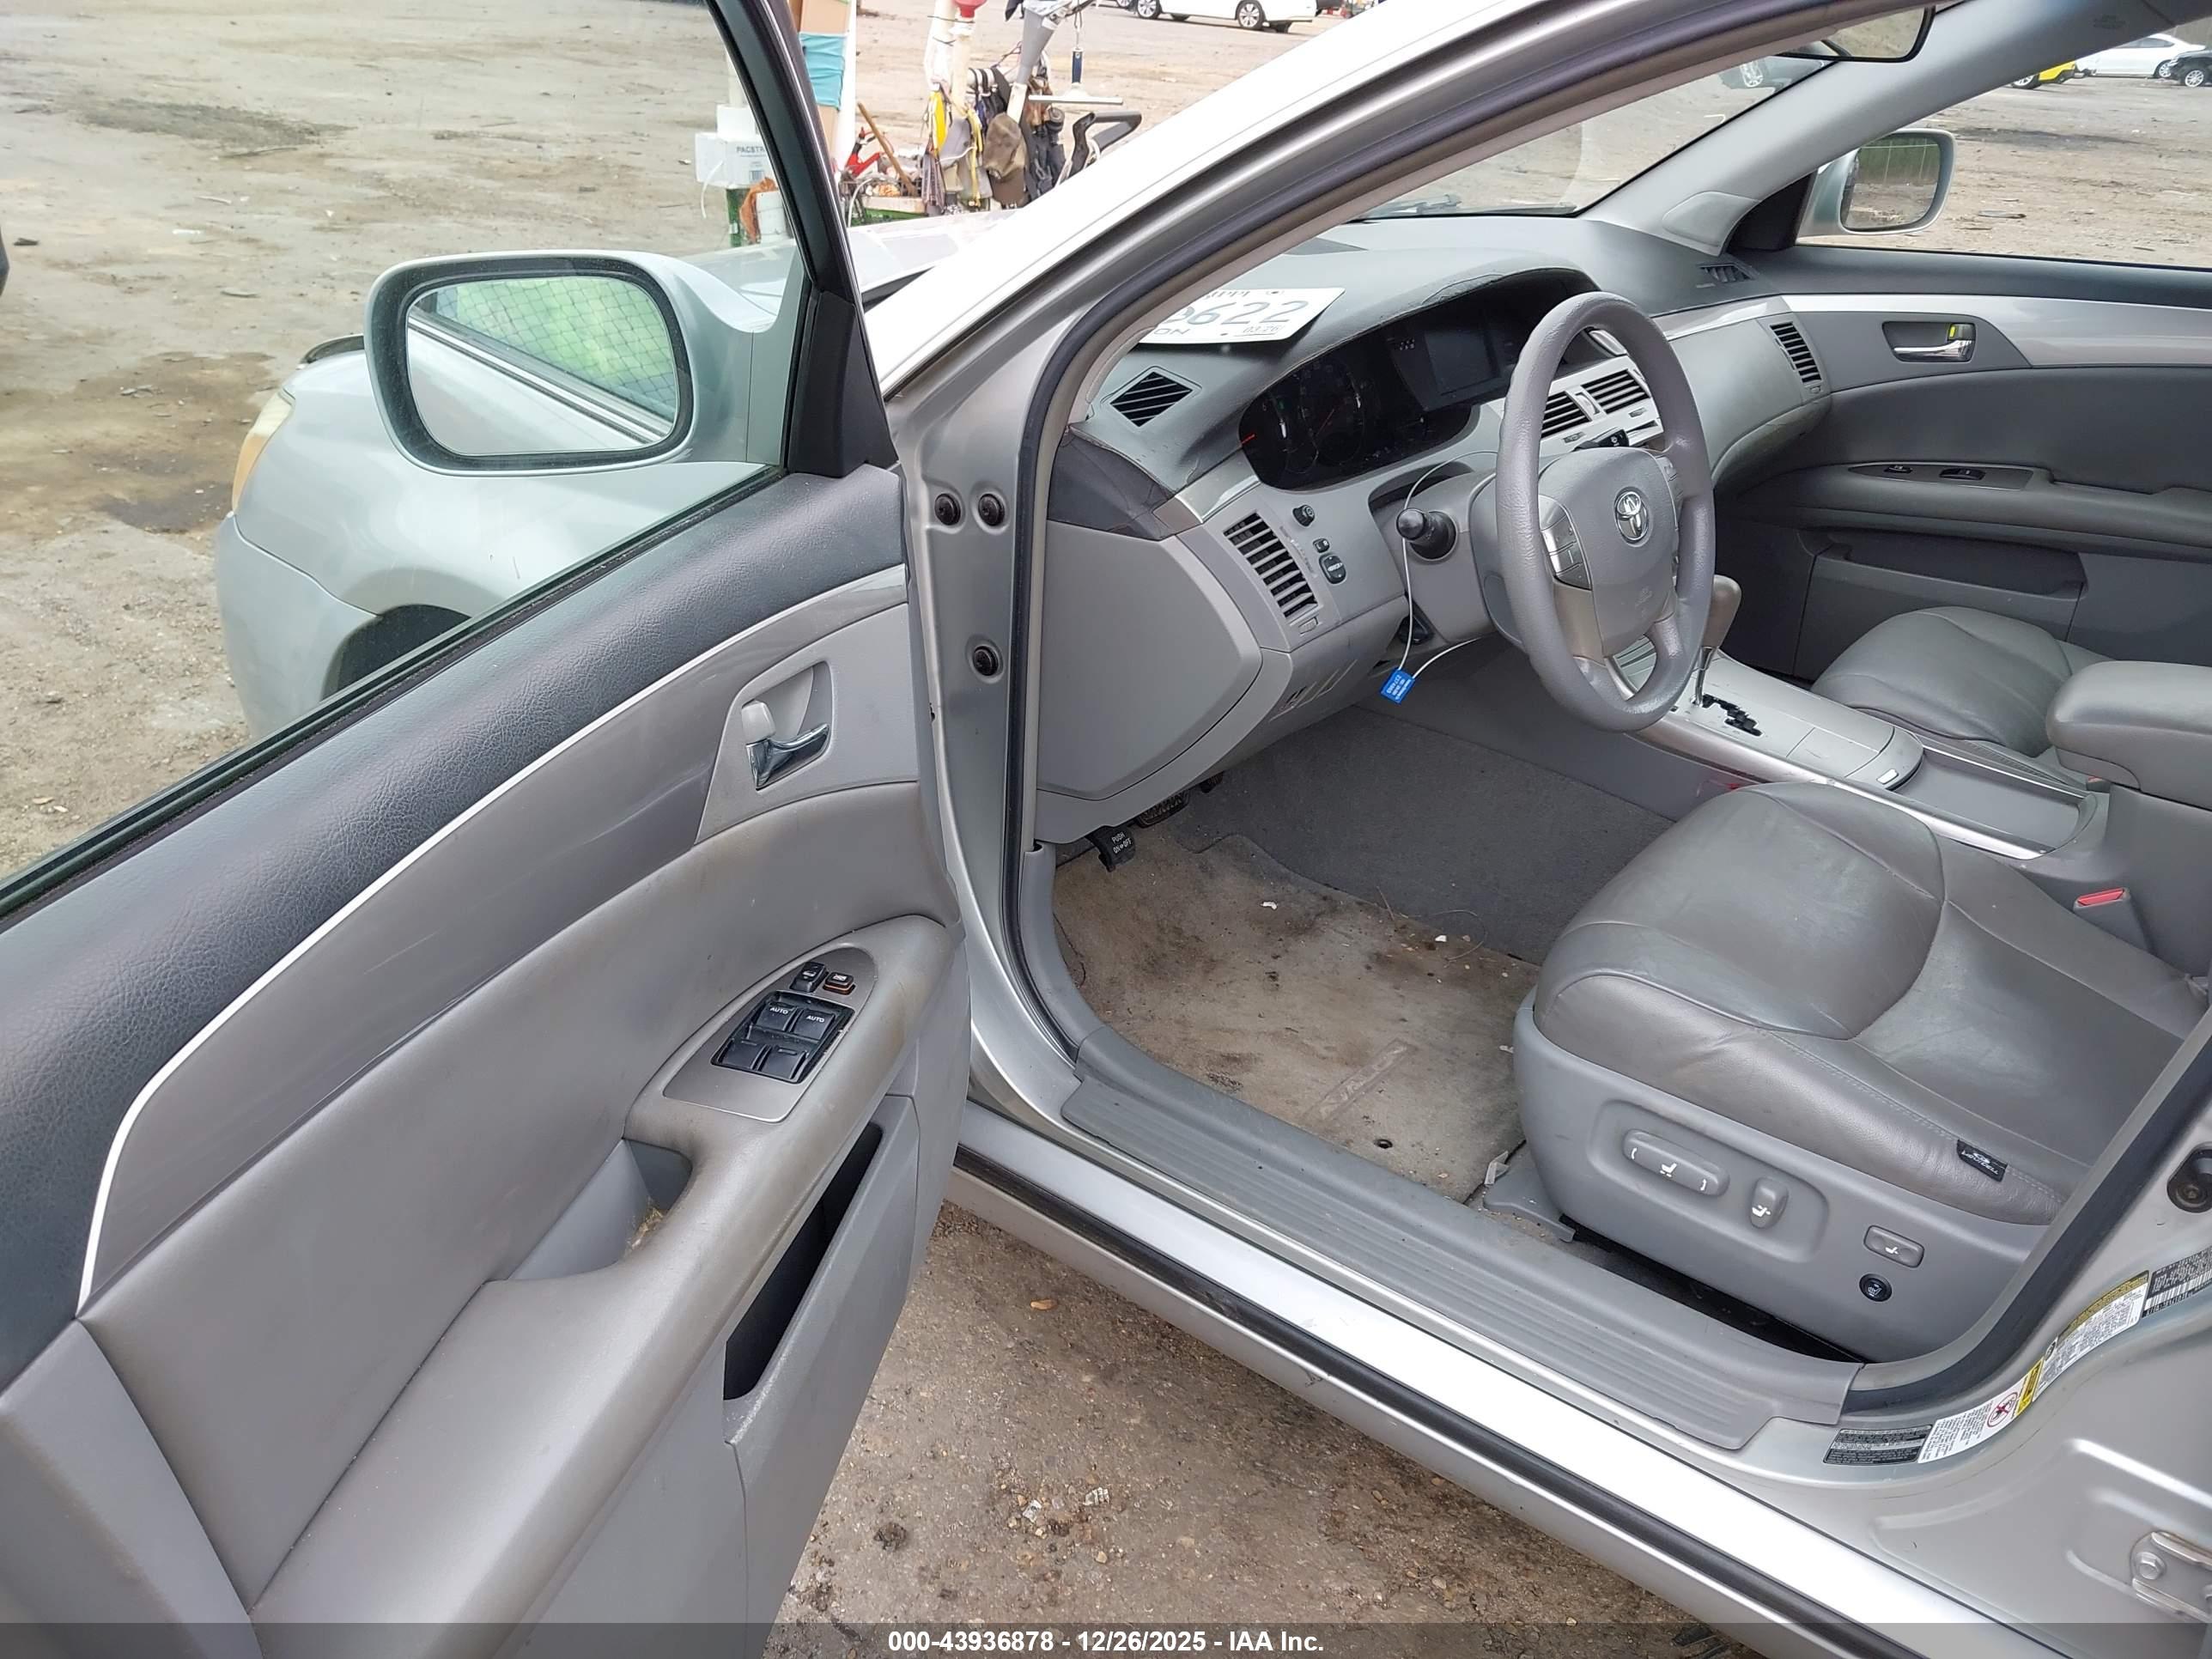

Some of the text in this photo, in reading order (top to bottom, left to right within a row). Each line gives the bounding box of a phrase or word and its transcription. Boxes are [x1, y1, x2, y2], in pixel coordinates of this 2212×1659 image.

[1111, 831, 1126, 844] PUSH
[769, 1006, 790, 1016] AUTO
[805, 1014, 826, 1024] AUTO
